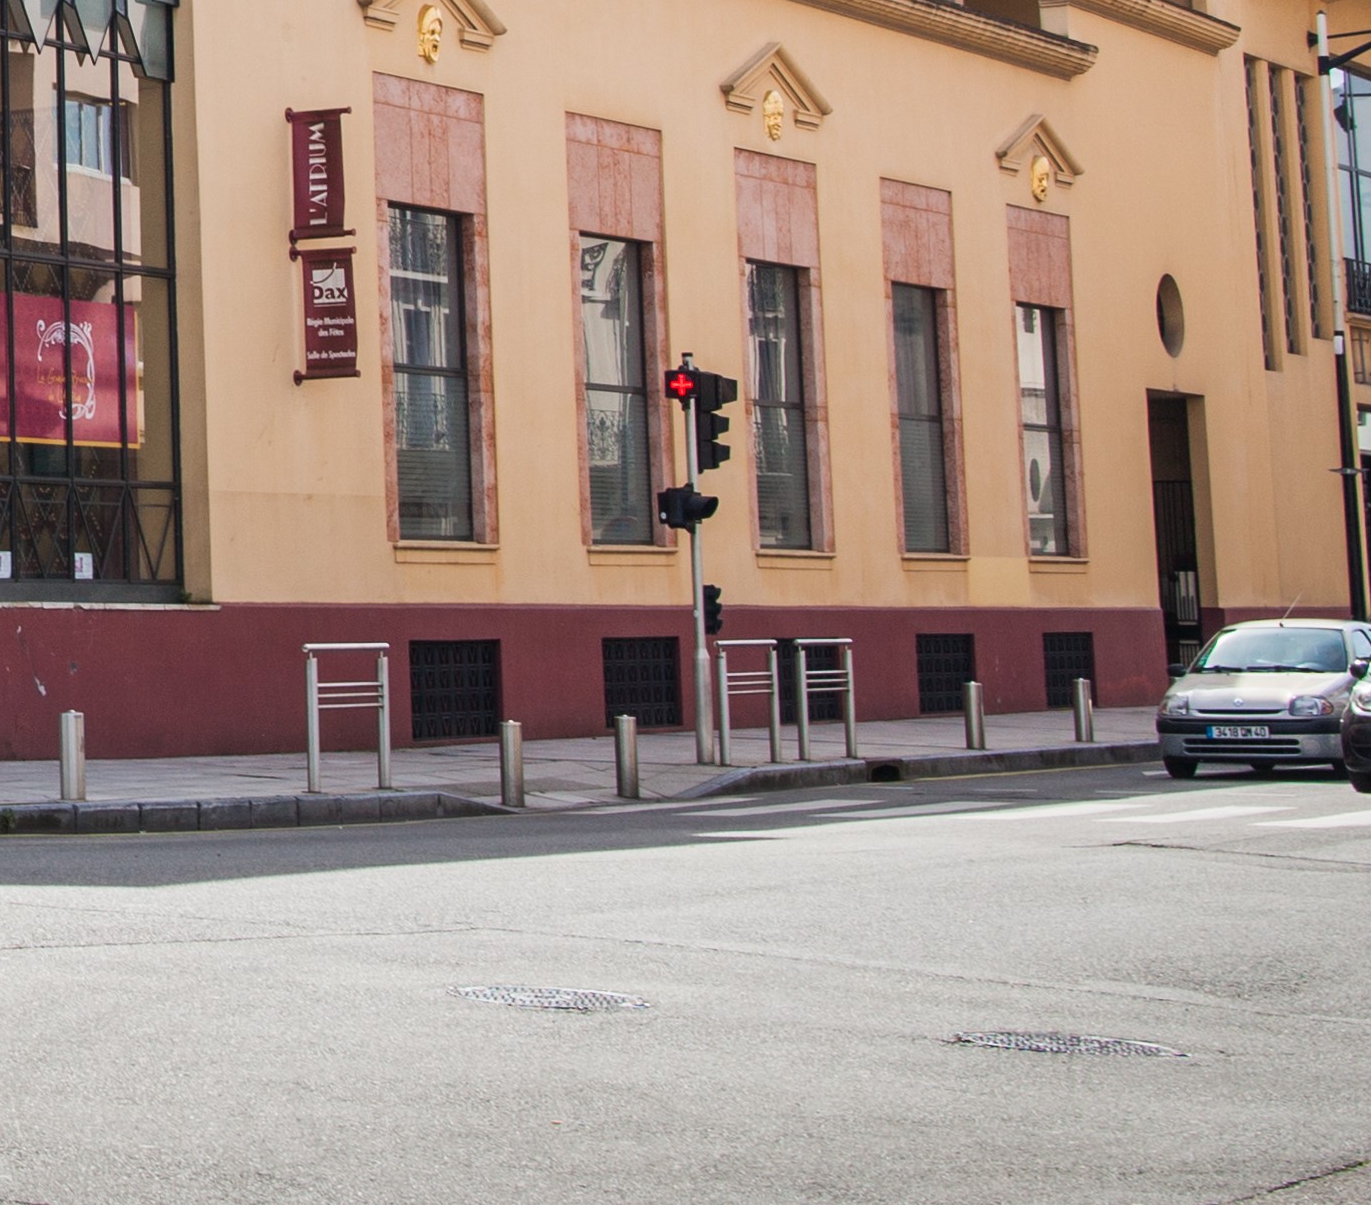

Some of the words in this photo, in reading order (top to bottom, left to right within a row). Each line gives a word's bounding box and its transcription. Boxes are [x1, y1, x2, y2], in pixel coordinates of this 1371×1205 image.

[308, 122, 328, 226] L'ATRIUM
[311, 285, 347, 301] Dax
[324, 315, 355, 326] Municipale
[306, 350, 320, 360] Salle
[320, 350, 328, 359] de
[328, 349, 356, 360] Spectacles
